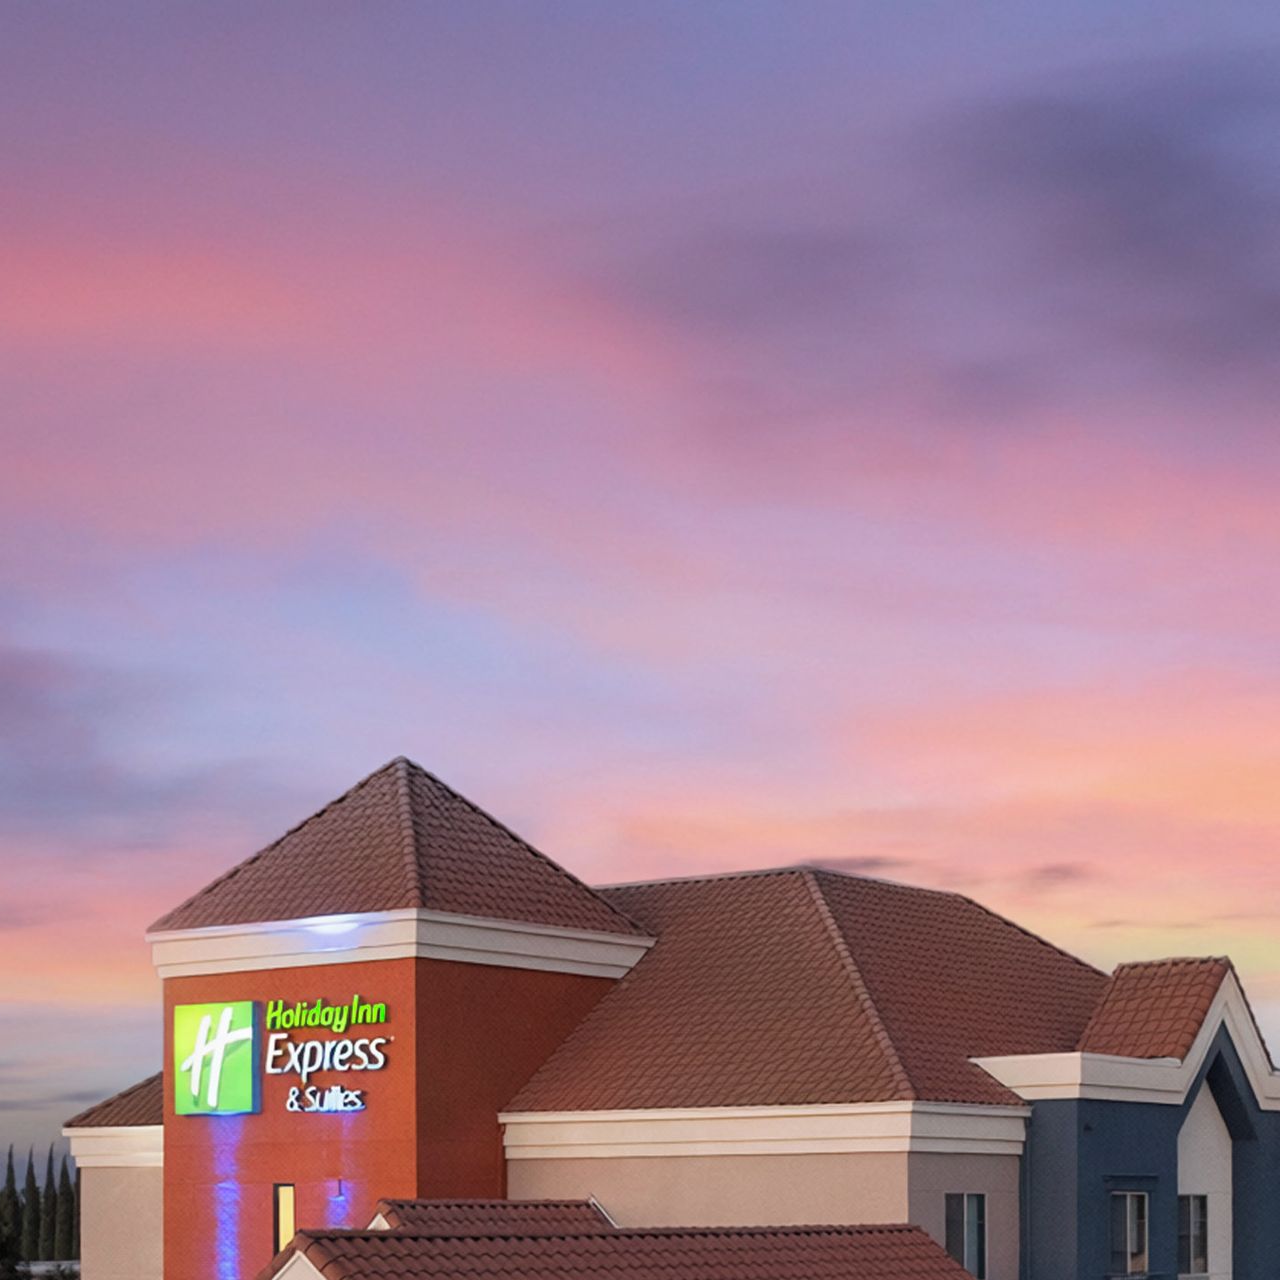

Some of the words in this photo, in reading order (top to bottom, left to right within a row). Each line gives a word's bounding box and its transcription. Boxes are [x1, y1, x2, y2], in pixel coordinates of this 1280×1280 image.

[265, 999, 348, 1033] Holiday
[350, 995, 387, 1024] Inn
[265, 1033, 387, 1083] Express
[286, 1086, 303, 1112] &
[303, 1085, 363, 1112] Suites
